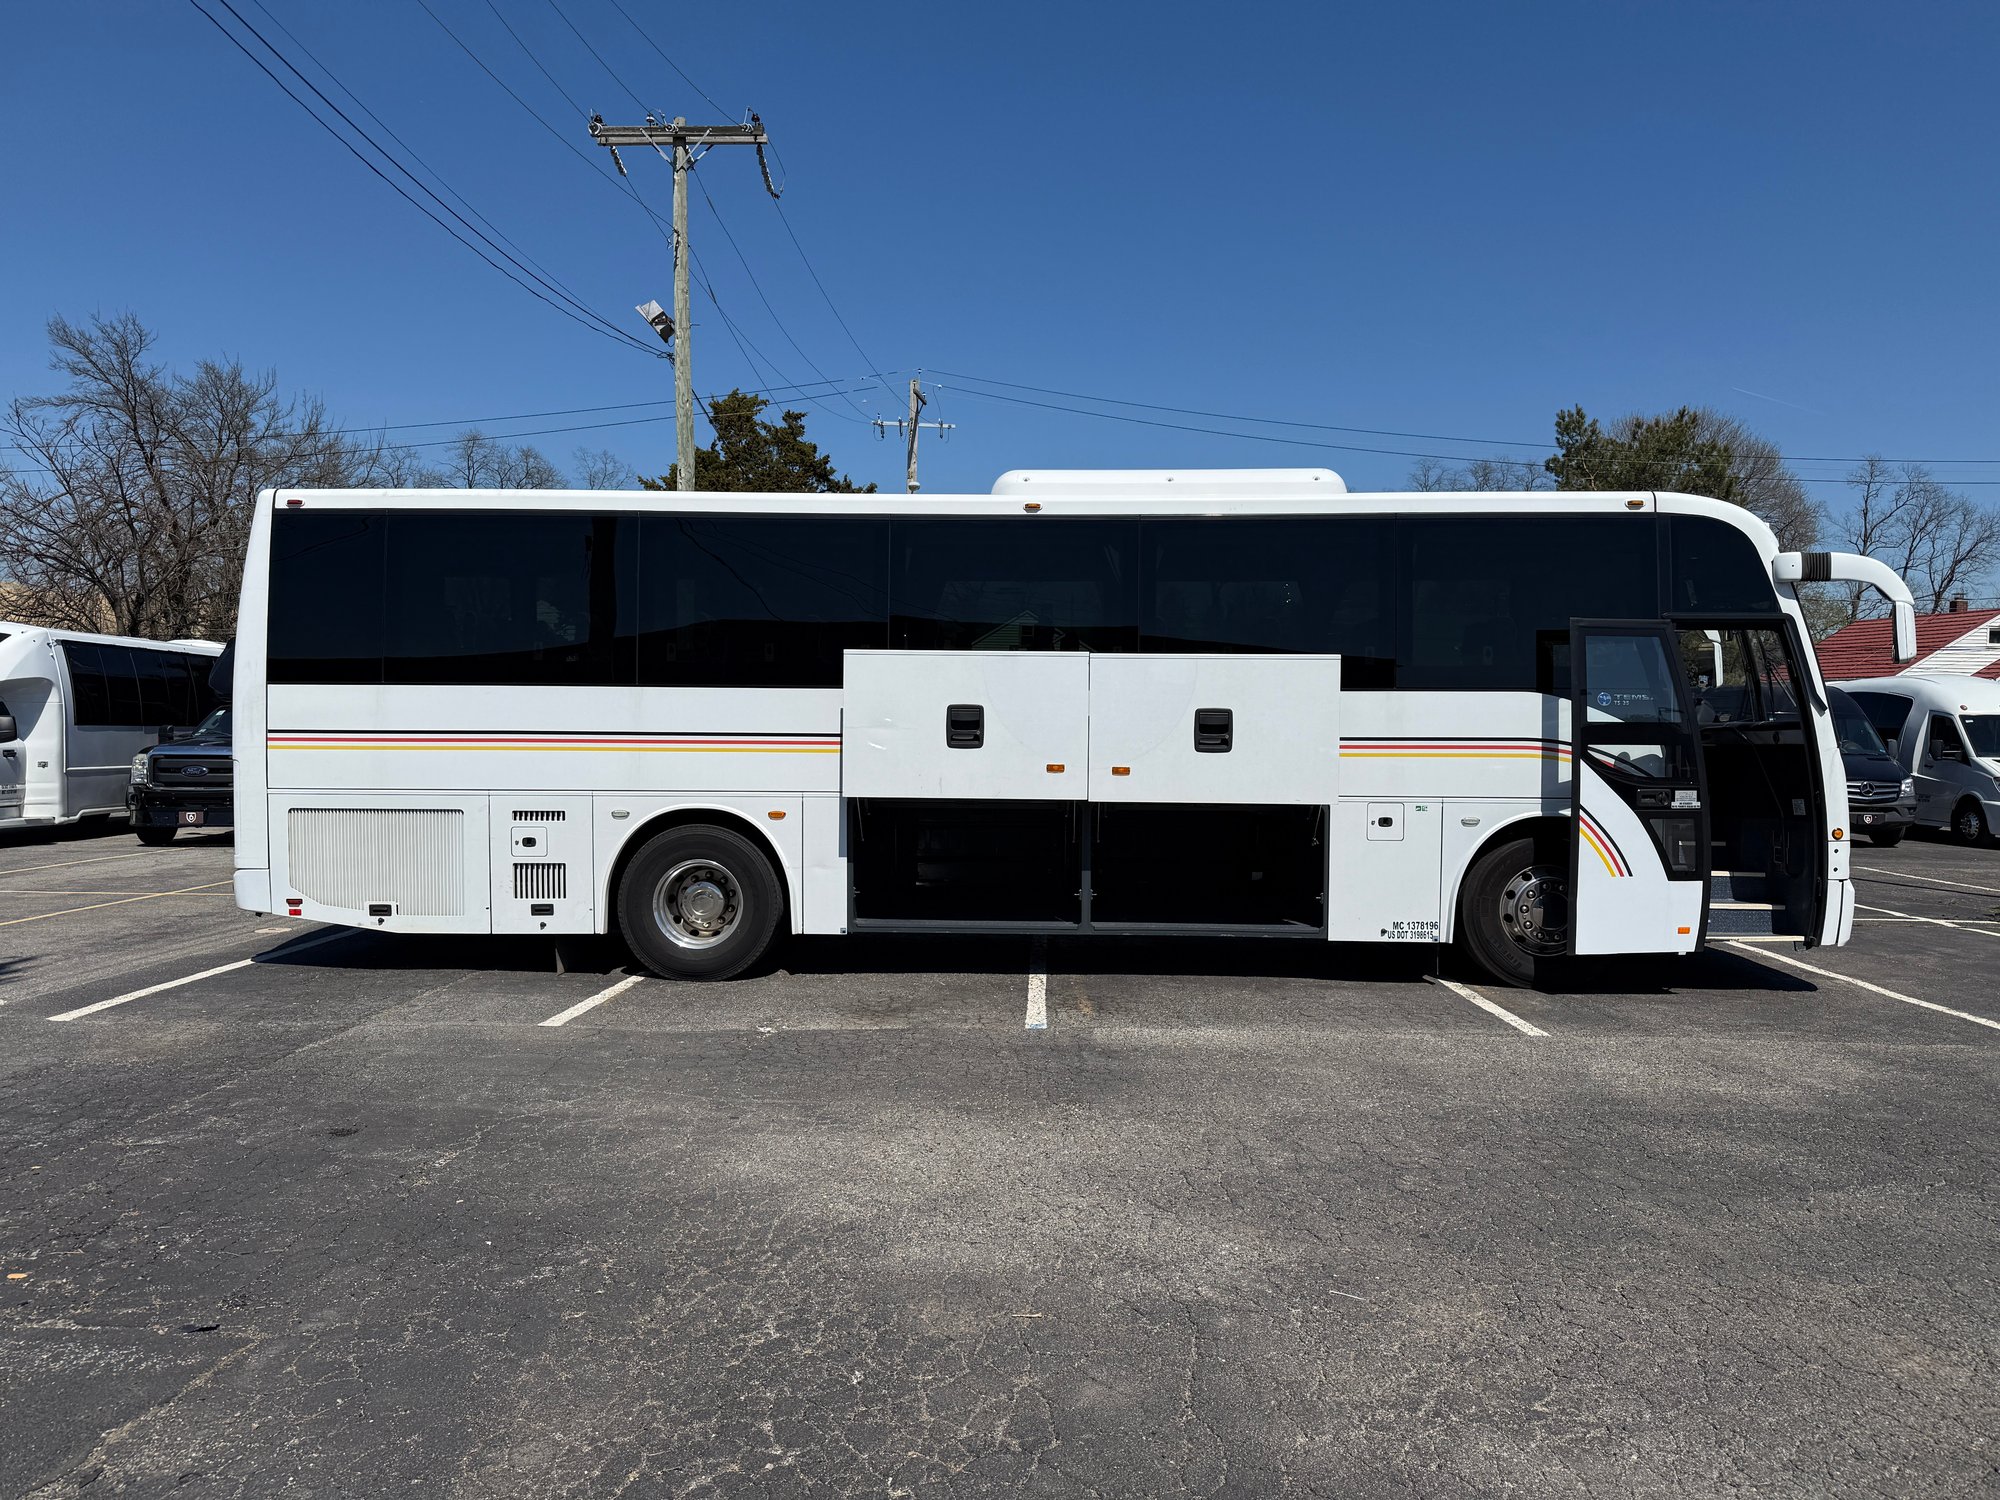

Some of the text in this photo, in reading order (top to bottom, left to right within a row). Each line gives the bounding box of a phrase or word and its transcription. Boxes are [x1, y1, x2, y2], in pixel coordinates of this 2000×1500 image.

[1392, 921, 1439, 930] MC 1378196
[1387, 930, 1396, 940] US
[1396, 930, 1409, 940] DOT
